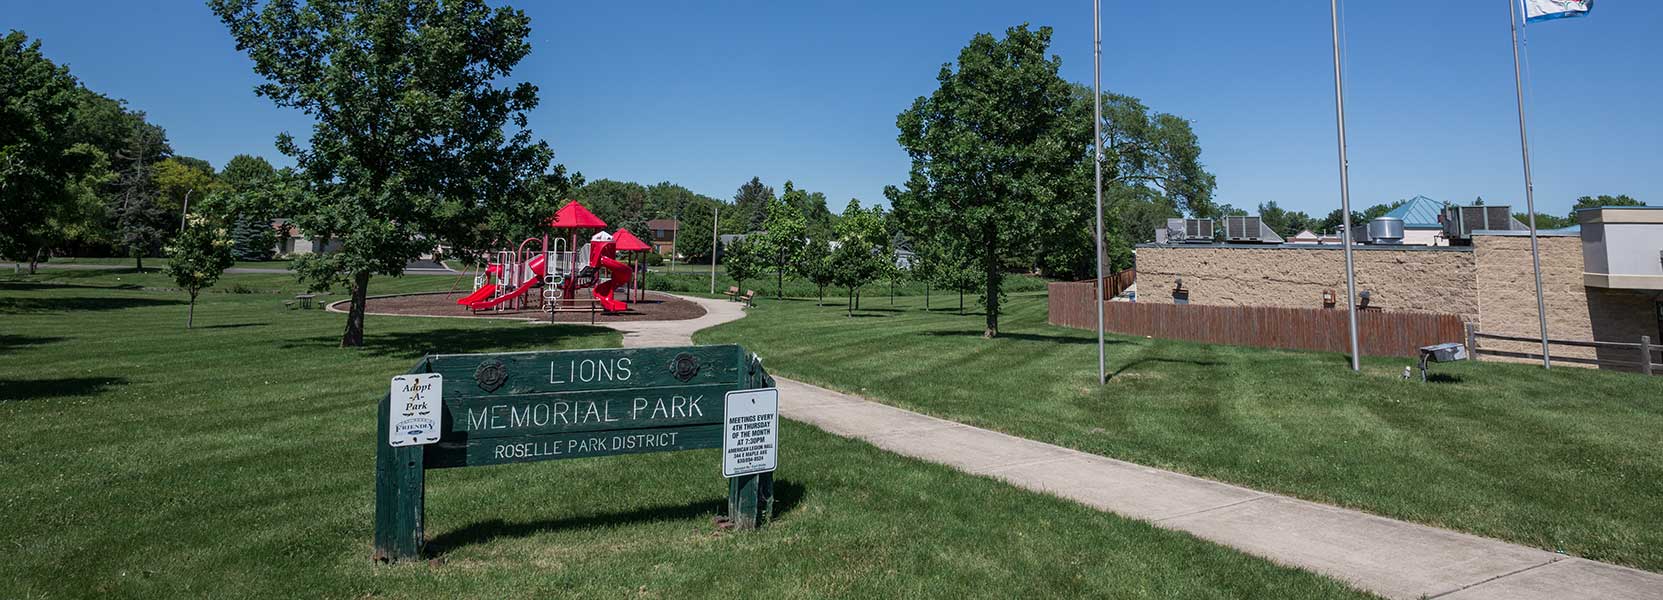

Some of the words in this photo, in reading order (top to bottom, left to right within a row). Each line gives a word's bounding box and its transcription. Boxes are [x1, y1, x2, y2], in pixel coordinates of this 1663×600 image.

[550, 357, 632, 385] LIONS
[402, 383, 431, 392] Adopt
[409, 393, 424, 401] -A-
[405, 402, 428, 411] Park
[467, 399, 619, 431] MEMORIAL
[632, 394, 704, 421] PARK
[729, 416, 756, 424] MEETINGS
[744, 421, 770, 430] THURSDAY
[732, 431, 739, 439] OF
[740, 430, 751, 438] THE
[751, 429, 771, 437] MONTH
[495, 440, 563, 459] ROSELLE
[568, 437, 607, 454] PARK
[612, 432, 679, 450] DISTRICT
